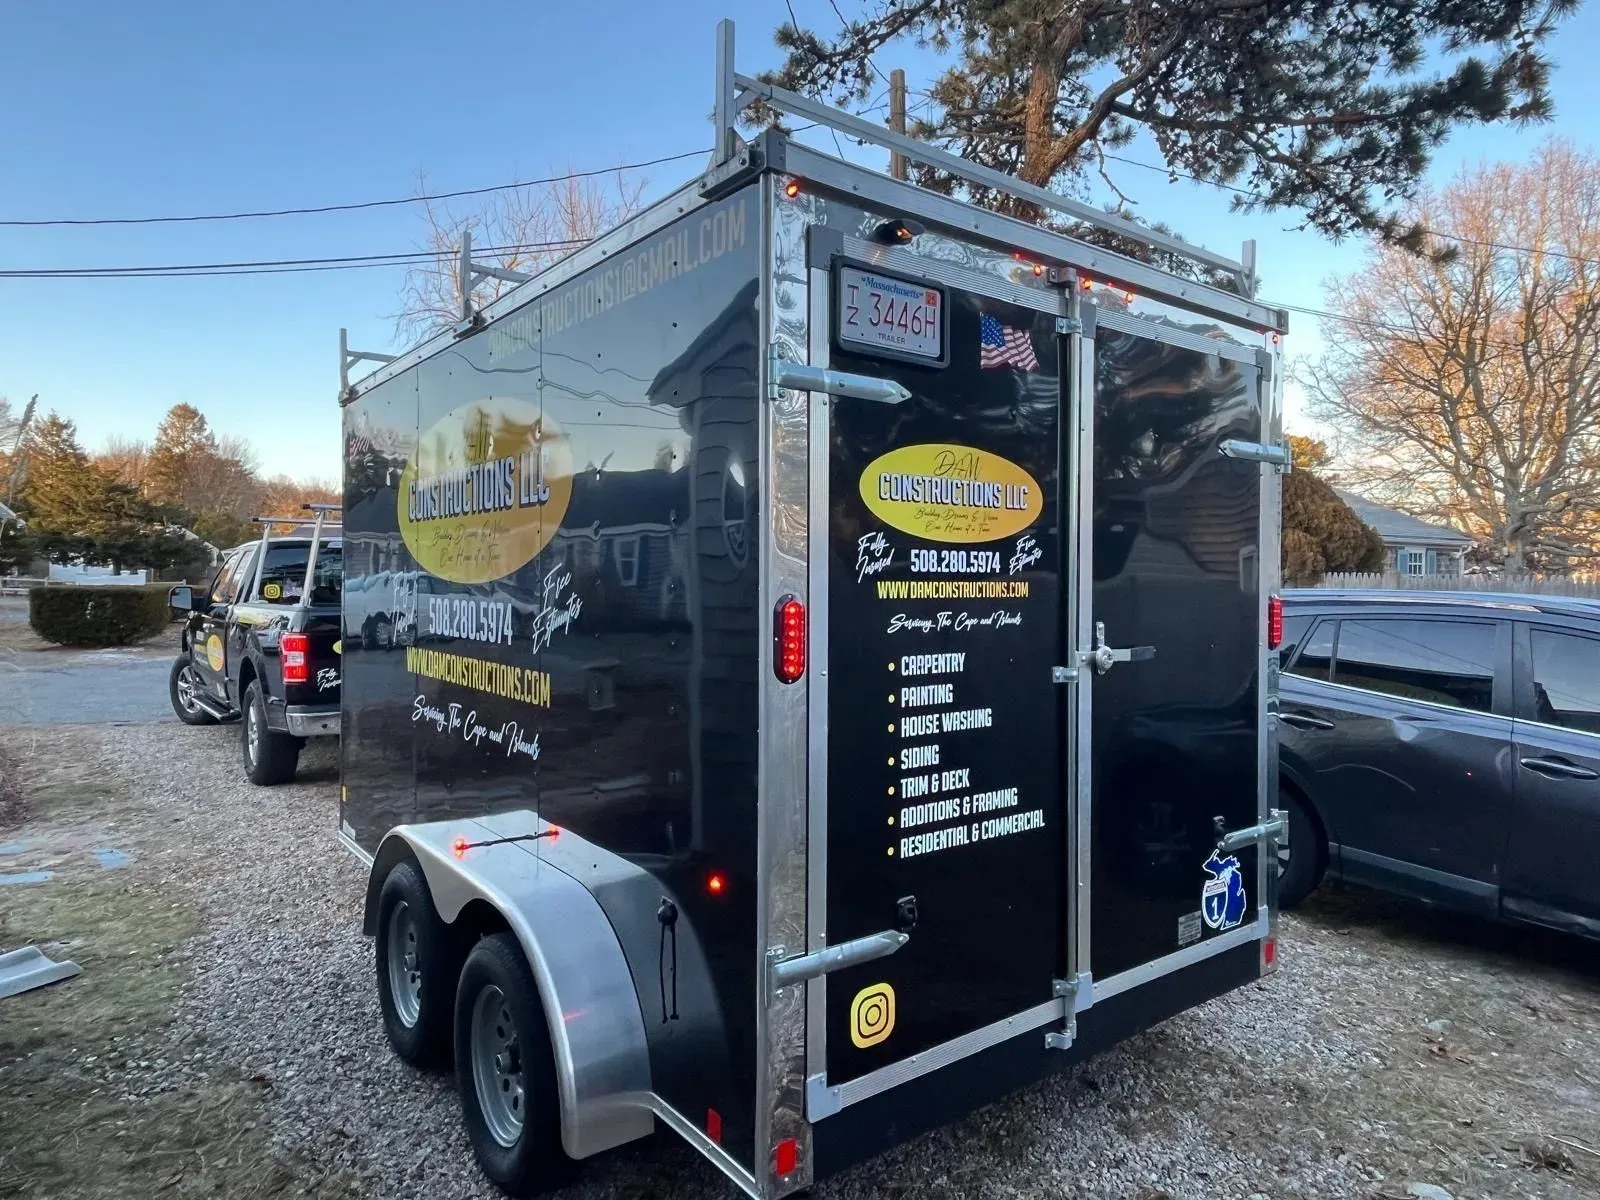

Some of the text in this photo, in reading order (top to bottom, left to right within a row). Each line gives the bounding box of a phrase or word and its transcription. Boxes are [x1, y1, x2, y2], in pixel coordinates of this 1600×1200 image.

[865, 276, 921, 298] Massachusetts
[869, 292, 936, 339] 3446H
[878, 333, 906, 344] TRAILER
[933, 450, 980, 480] DAM
[408, 449, 551, 523] CONSTRUCTIONS LLC
[879, 472, 1029, 511] CONSTRUCTIONS LLC
[858, 532, 890, 557] Fully
[1016, 535, 1036, 556] Free
[856, 548, 895, 584] Insured
[911, 549, 1001, 573] 508.280.5974
[543, 563, 572, 611] Free
[429, 598, 513, 645] 508.280.5974
[533, 592, 584, 654] Estimates
[937, 612, 952, 631] The
[955, 612, 979, 631] Cape
[980, 613, 995, 625] and
[995, 611, 1022, 629] Islands
[406, 646, 551, 709] WWW.DAMCONSTRUCTIONS.COM
[901, 653, 966, 676] CARPENTRY
[901, 684, 953, 708] PAINTING
[412, 695, 540, 760] Servicing The Cape and Islands
[901, 708, 992, 738] HOUSE WASHING
[901, 745, 940, 769] SIDING
[901, 768, 970, 799] TRIM & DECK
[901, 787, 1018, 828] ADDITIONS & FRAMING
[901, 809, 1045, 859] RESIDENTIAL & COMMERCIAL
[1212, 897, 1219, 921] 1
